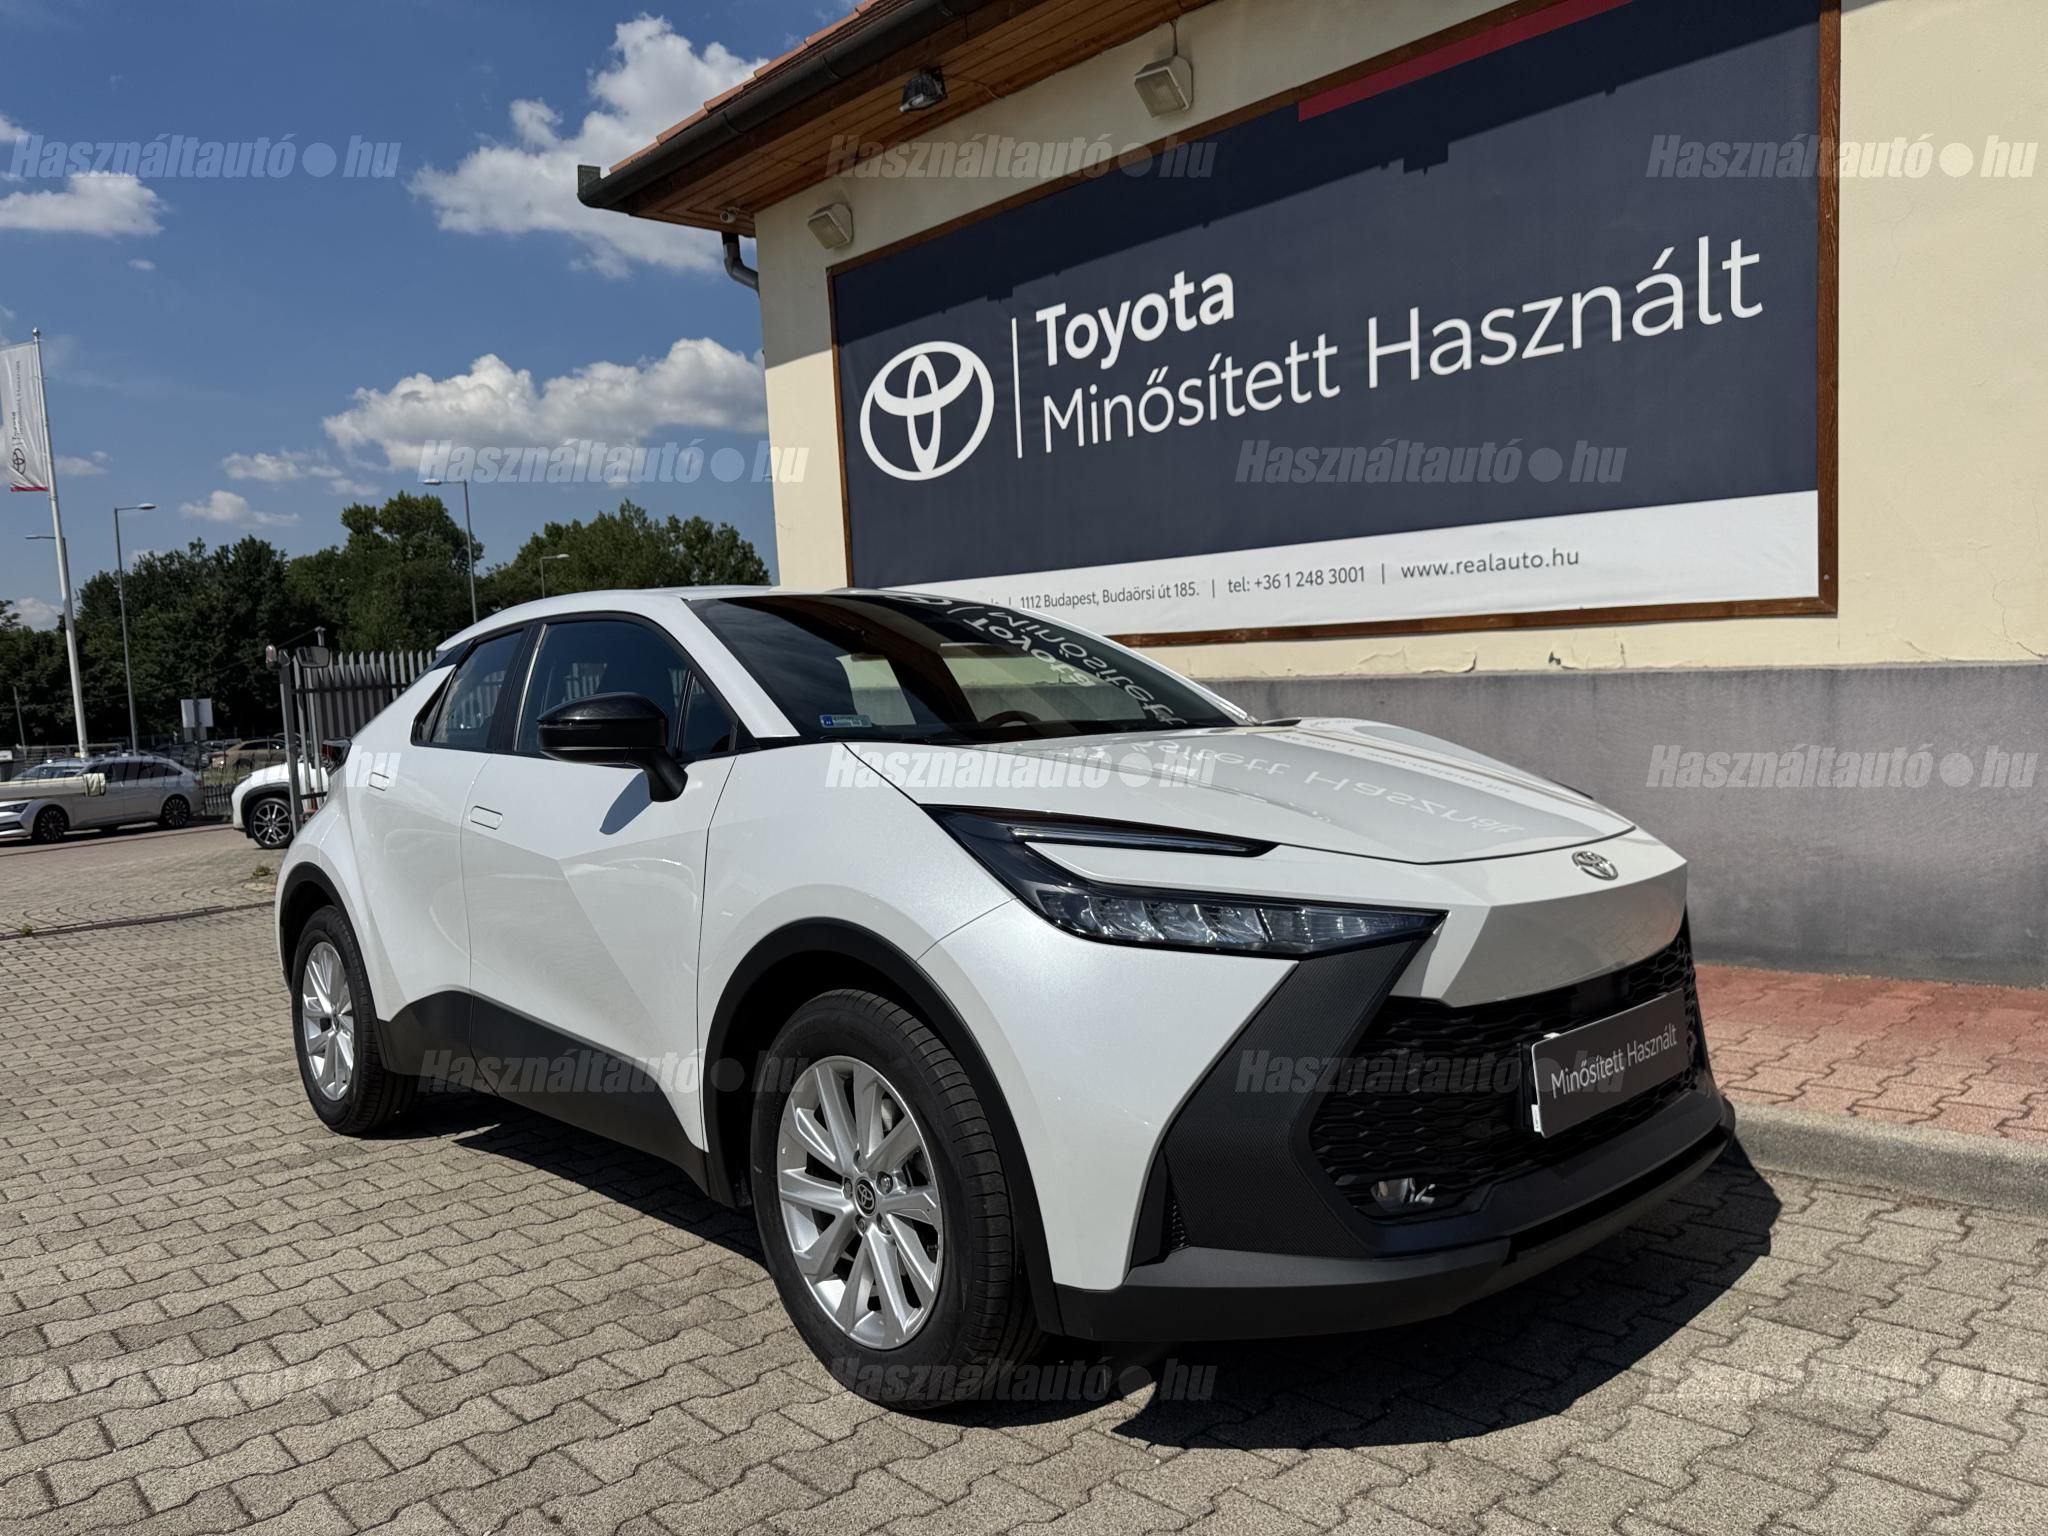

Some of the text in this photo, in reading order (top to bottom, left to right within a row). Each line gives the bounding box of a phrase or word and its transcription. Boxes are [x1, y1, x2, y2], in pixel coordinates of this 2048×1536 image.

[1035, 270, 1235, 370] Toyota
[1042, 235, 1764, 454] Minősített Használt
[1021, 548, 1580, 609] 1112 Budapest, Budaörsi út 185. tel: +36 1 248 3001 www.realauto.hu
[1550, 1022, 1678, 1100] Minősített Használt
